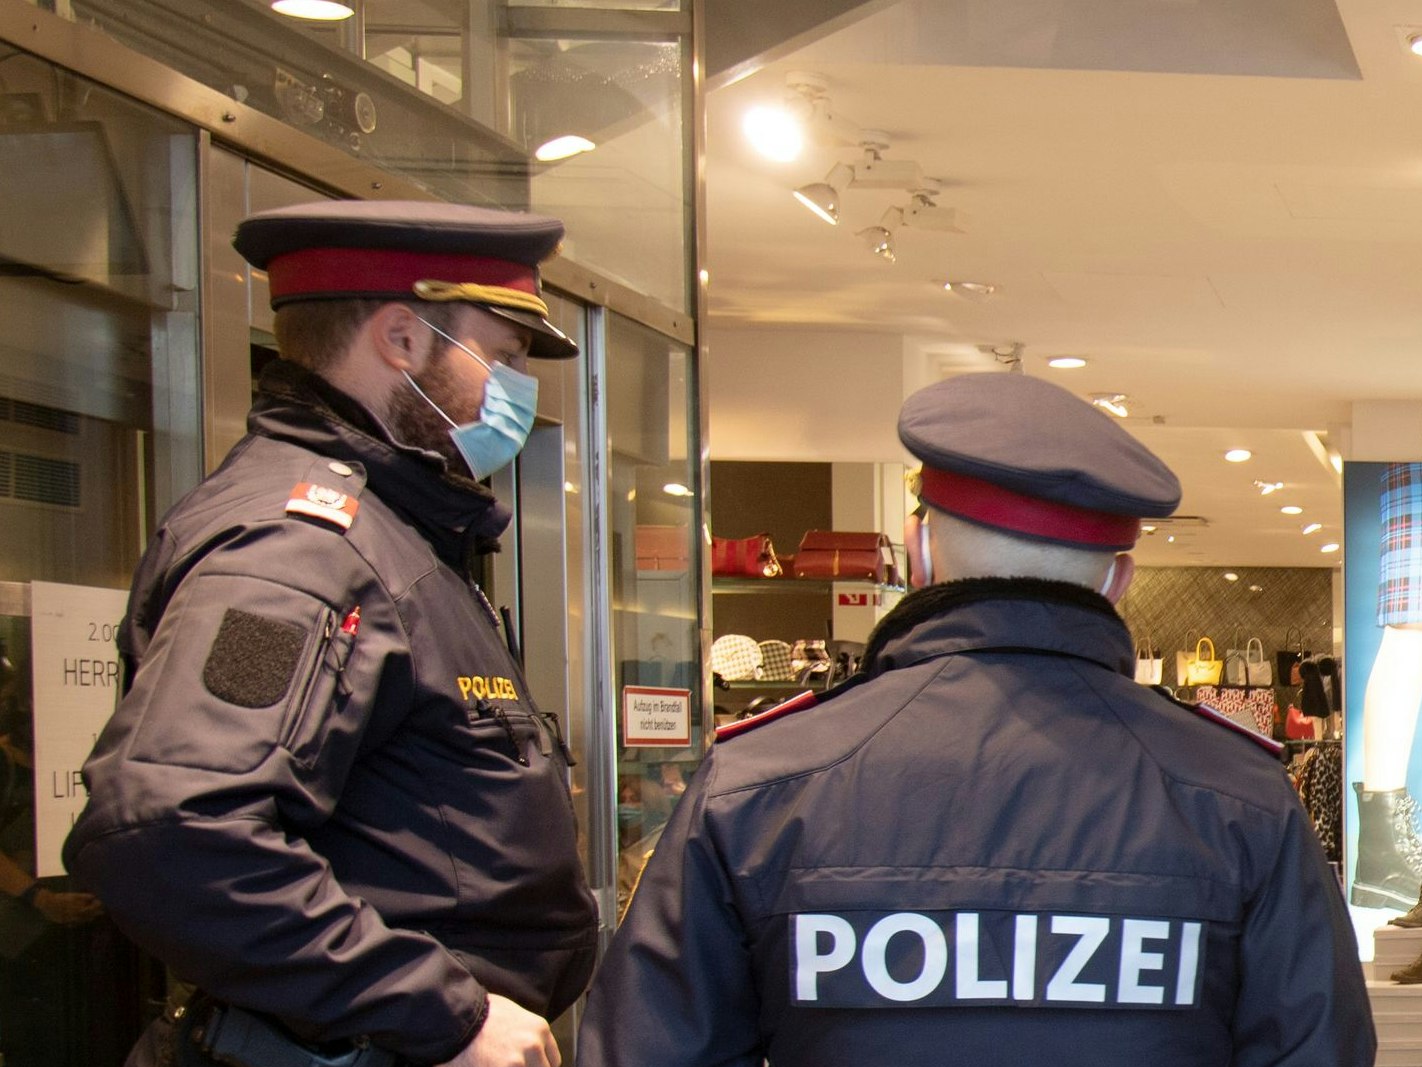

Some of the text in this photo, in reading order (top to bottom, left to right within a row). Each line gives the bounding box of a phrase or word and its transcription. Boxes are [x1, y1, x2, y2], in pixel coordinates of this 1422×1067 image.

[63, 658, 119, 687] HERR
[457, 675, 519, 701] POLIZEI
[796, 912, 1201, 1005] POLIZEI
